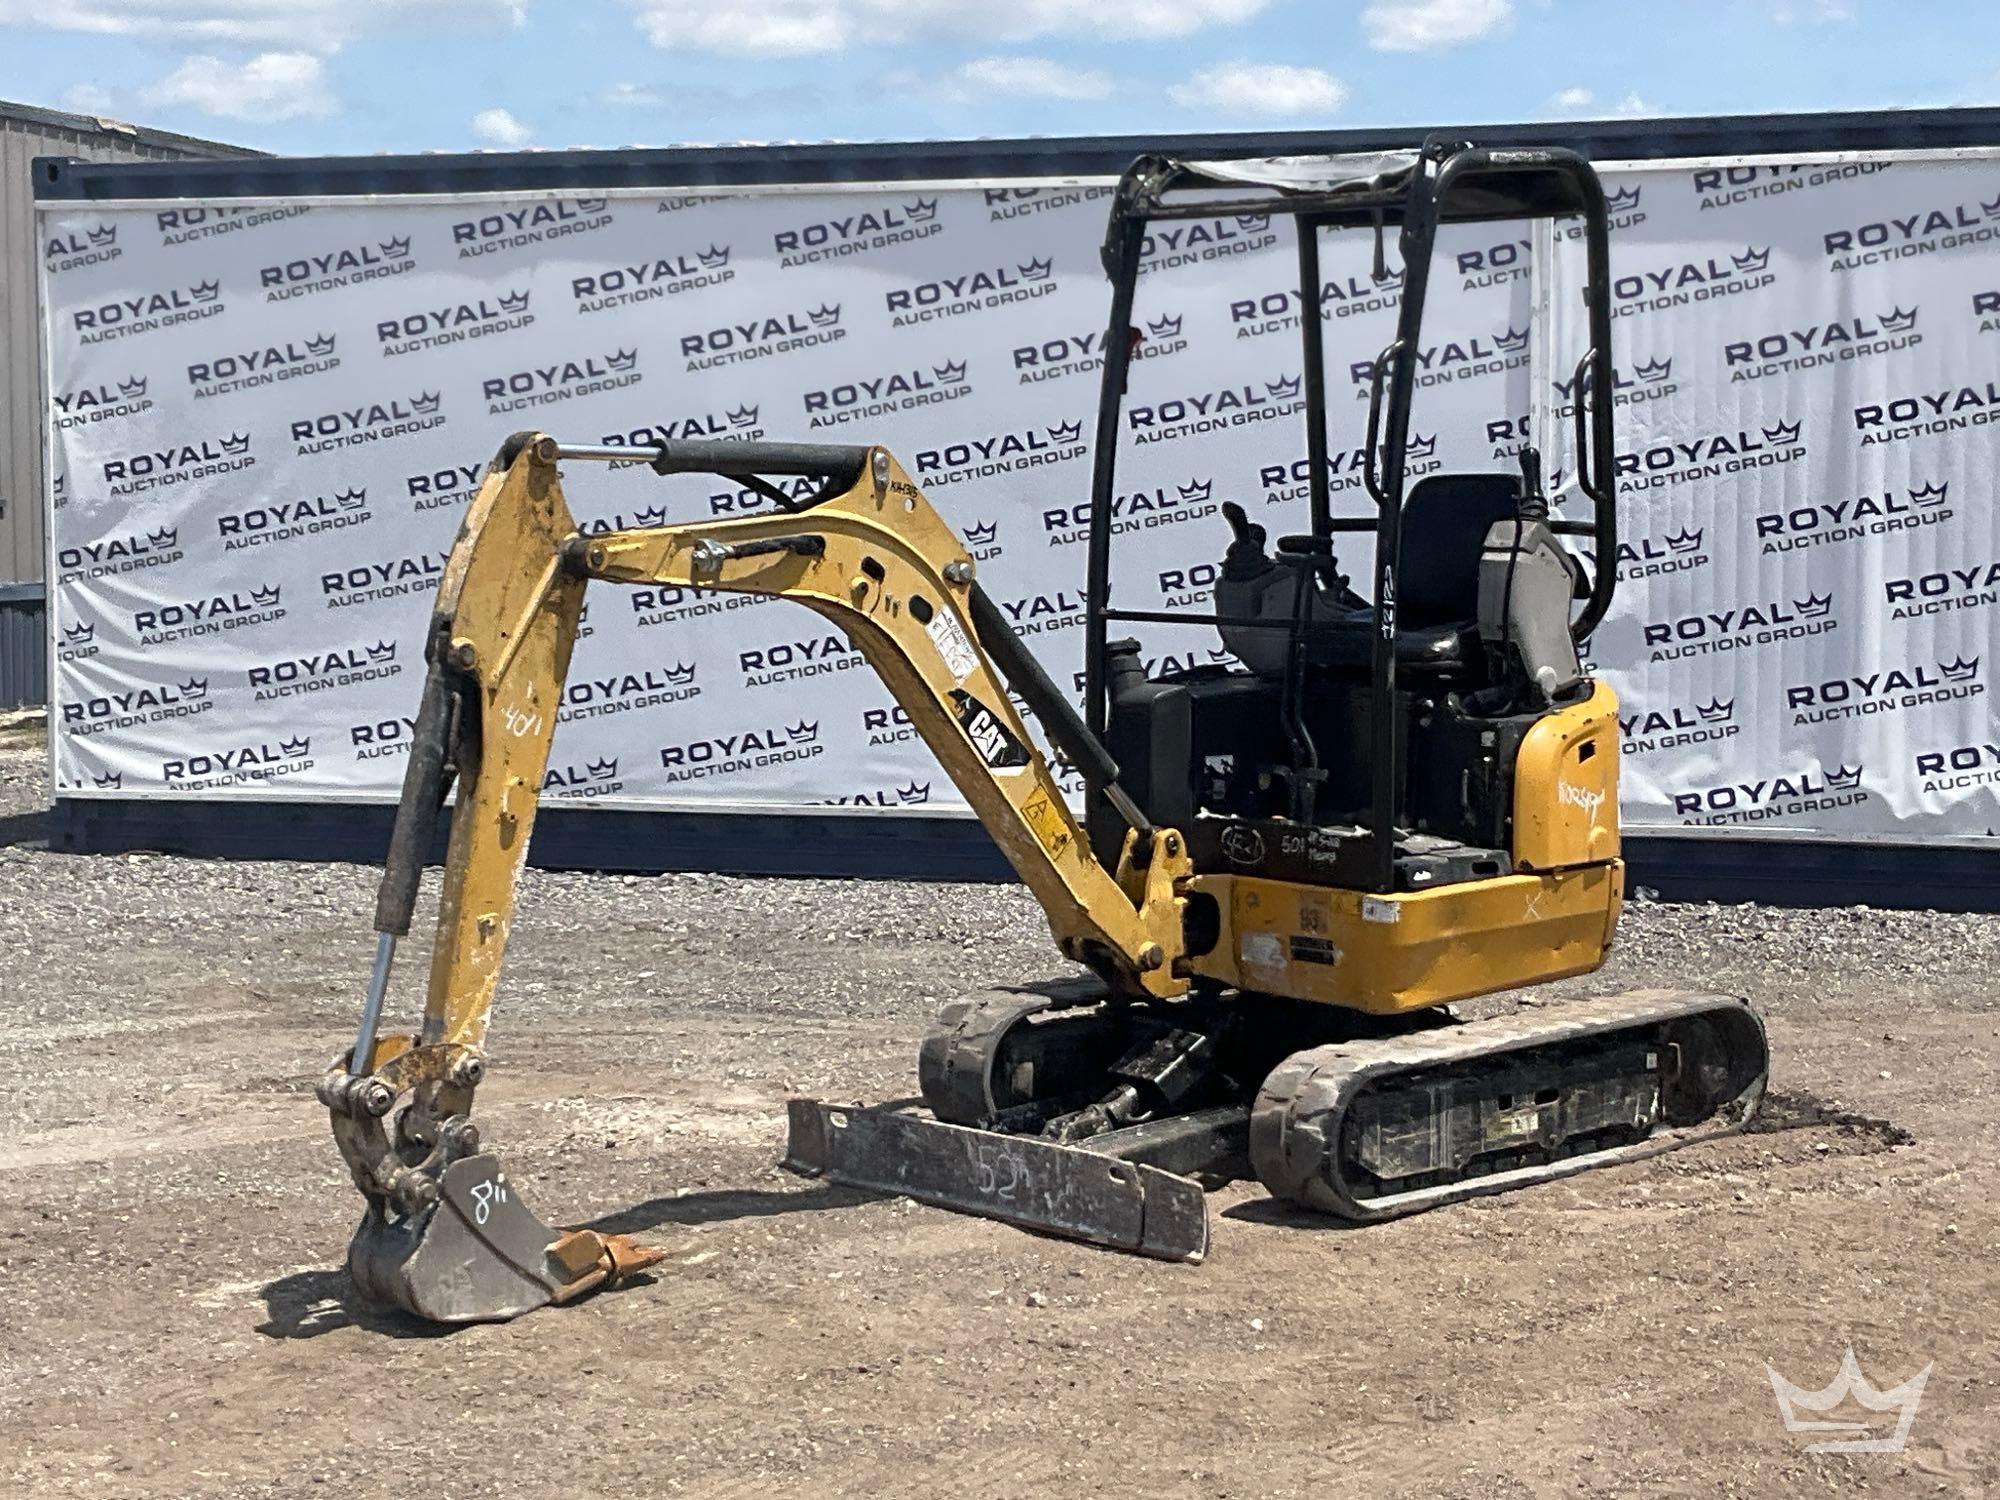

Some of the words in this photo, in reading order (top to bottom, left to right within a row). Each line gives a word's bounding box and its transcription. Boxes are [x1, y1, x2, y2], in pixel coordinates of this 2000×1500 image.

[992, 192, 1080, 222] AUCTION
[1700, 178, 1803, 210] AUCTION
[164, 220, 242, 246] AUCTION
[453, 198, 578, 244] ROYAL
[459, 231, 543, 259] AUCTION
[546, 216, 612, 238] GROUP
[775, 210, 904, 255] ROYAL
[1140, 220, 1237, 257] OYAL
[1824, 206, 1980, 256] ROYAL
[61, 248, 122, 270] GROUP
[782, 240, 868, 268] AUCTION
[872, 224, 942, 248] GROUP
[1137, 252, 1198, 275] CTION
[1202, 235, 1276, 260] GROUP
[1831, 240, 1936, 272] AUCTION
[260, 246, 380, 290] ROYAL
[268, 276, 347, 302] AUCTION
[351, 260, 416, 283] GROUP
[572, 256, 698, 301] ROYAL
[1463, 266, 1531, 291] AUCTI
[1614, 259, 1731, 299] OYAL
[1694, 274, 1775, 300] GROUP
[74, 290, 190, 330] ROYAL
[580, 286, 662, 314] AUCTION
[668, 270, 734, 294] GROUP
[886, 268, 1018, 314] ROYAL
[893, 300, 981, 327] AUCTION
[986, 283, 1056, 307] GROUP
[80, 320, 158, 344] AUCTION
[162, 304, 224, 326] GROUP
[378, 301, 498, 344] ROYAL
[384, 330, 464, 356] AUCTION
[469, 316, 534, 338] GROUP
[680, 314, 808, 359] ROYAL
[1236, 309, 1330, 339] AUCTIN
[1336, 295, 1399, 318] GROU
[687, 346, 772, 372] AUCTION
[776, 329, 846, 352] GROUP
[1014, 332, 1105, 369] ROY
[1725, 318, 1878, 368] ROYAL
[1732, 352, 1834, 382] AUCTION
[1840, 334, 1922, 360] GROUP
[188, 344, 306, 384] ROYAL
[195, 374, 273, 398] AUCTION
[278, 358, 340, 380] GROUP
[483, 359, 606, 400] ROYAL
[53, 385, 118, 413] YAL
[90, 400, 152, 422] GROUP
[490, 390, 570, 414] AUCTION
[576, 374, 641, 396] GROUP
[804, 371, 934, 416] ROYAL
[810, 401, 897, 428] AUCTION
[902, 386, 972, 408] GROUP
[1129, 386, 1266, 432] ROYAL
[1614, 384, 1677, 407] ROUP
[292, 402, 410, 441] ROYAL
[298, 430, 378, 456] AUCTION
[382, 416, 445, 438] GROUP
[1136, 418, 1228, 445] AUCTION
[1231, 401, 1306, 427] GROUP
[1861, 416, 1966, 446] AUCTION
[104, 442, 220, 482] ROYAL
[916, 432, 1048, 473] ROYAL
[922, 462, 1011, 488] AUCTION
[1016, 446, 1086, 469] GROUP
[1614, 431, 1762, 476] ROYAL
[1620, 464, 1720, 492] AUCTION
[1726, 448, 1806, 472] GROUP
[111, 471, 188, 496] AUCTION
[193, 457, 255, 478] GROUP
[408, 464, 482, 497] ROY
[1266, 476, 1360, 504] AUCON
[218, 498, 336, 536] ROYAL
[414, 488, 477, 512] AUCTI
[1756, 493, 1908, 538] ROYAL
[226, 526, 304, 550] AUCTION
[308, 512, 371, 534] GROUP
[1049, 520, 1139, 546] AUCON
[1145, 505, 1217, 528] GROUP
[1762, 526, 1864, 555] AUCTION
[1870, 510, 1953, 534] GROUP
[58, 537, 149, 568] OYAL
[122, 552, 183, 572] GROUP
[1630, 556, 1708, 578] GROUP
[321, 555, 441, 594] ROYAL
[1885, 563, 2000, 603] ROYA
[135, 594, 252, 633] ROYAL
[328, 584, 408, 608] AUCTION
[638, 602, 722, 626] AUCTION
[1002, 592, 1079, 620] YAL
[1892, 591, 1997, 620] AUCTION
[141, 622, 220, 646] AUCTION
[224, 610, 286, 629] GROUP
[1046, 614, 1088, 631] GRO
[1644, 604, 1794, 648] ROYAL
[1651, 636, 1751, 662] AUCTION
[1756, 620, 1837, 644] GROUP
[248, 650, 366, 688] ROYAL
[739, 636, 858, 673] ROYA
[255, 678, 334, 701] AUCTION
[338, 665, 401, 686] GROUP
[558, 672, 665, 707] OYAL
[746, 662, 832, 688] AUCTION
[1787, 666, 1939, 712] ROYAL
[63, 687, 179, 724] ROYAL
[70, 714, 146, 736] AUCTION
[151, 702, 212, 721] GROUP
[556, 700, 630, 723] UCTION
[635, 688, 700, 708] GROUP
[1619, 707, 1696, 737] YAL
[1794, 699, 1896, 726] AUCTION
[1902, 684, 1984, 707] GROUP
[357, 741, 411, 760] AUCTI
[661, 730, 786, 770] ROYAL
[869, 728, 918, 746] AUCT
[968, 709, 1008, 762] CAT
[1660, 726, 1740, 748] GROUP
[164, 745, 281, 782] ROYAL
[252, 759, 314, 780] GROUP
[667, 759, 751, 782] AUCTION
[756, 746, 823, 766] GROUP
[1917, 744, 2000, 776] ROY
[1674, 775, 1824, 815] ROYAL
[1788, 793, 1868, 814] GROUP
